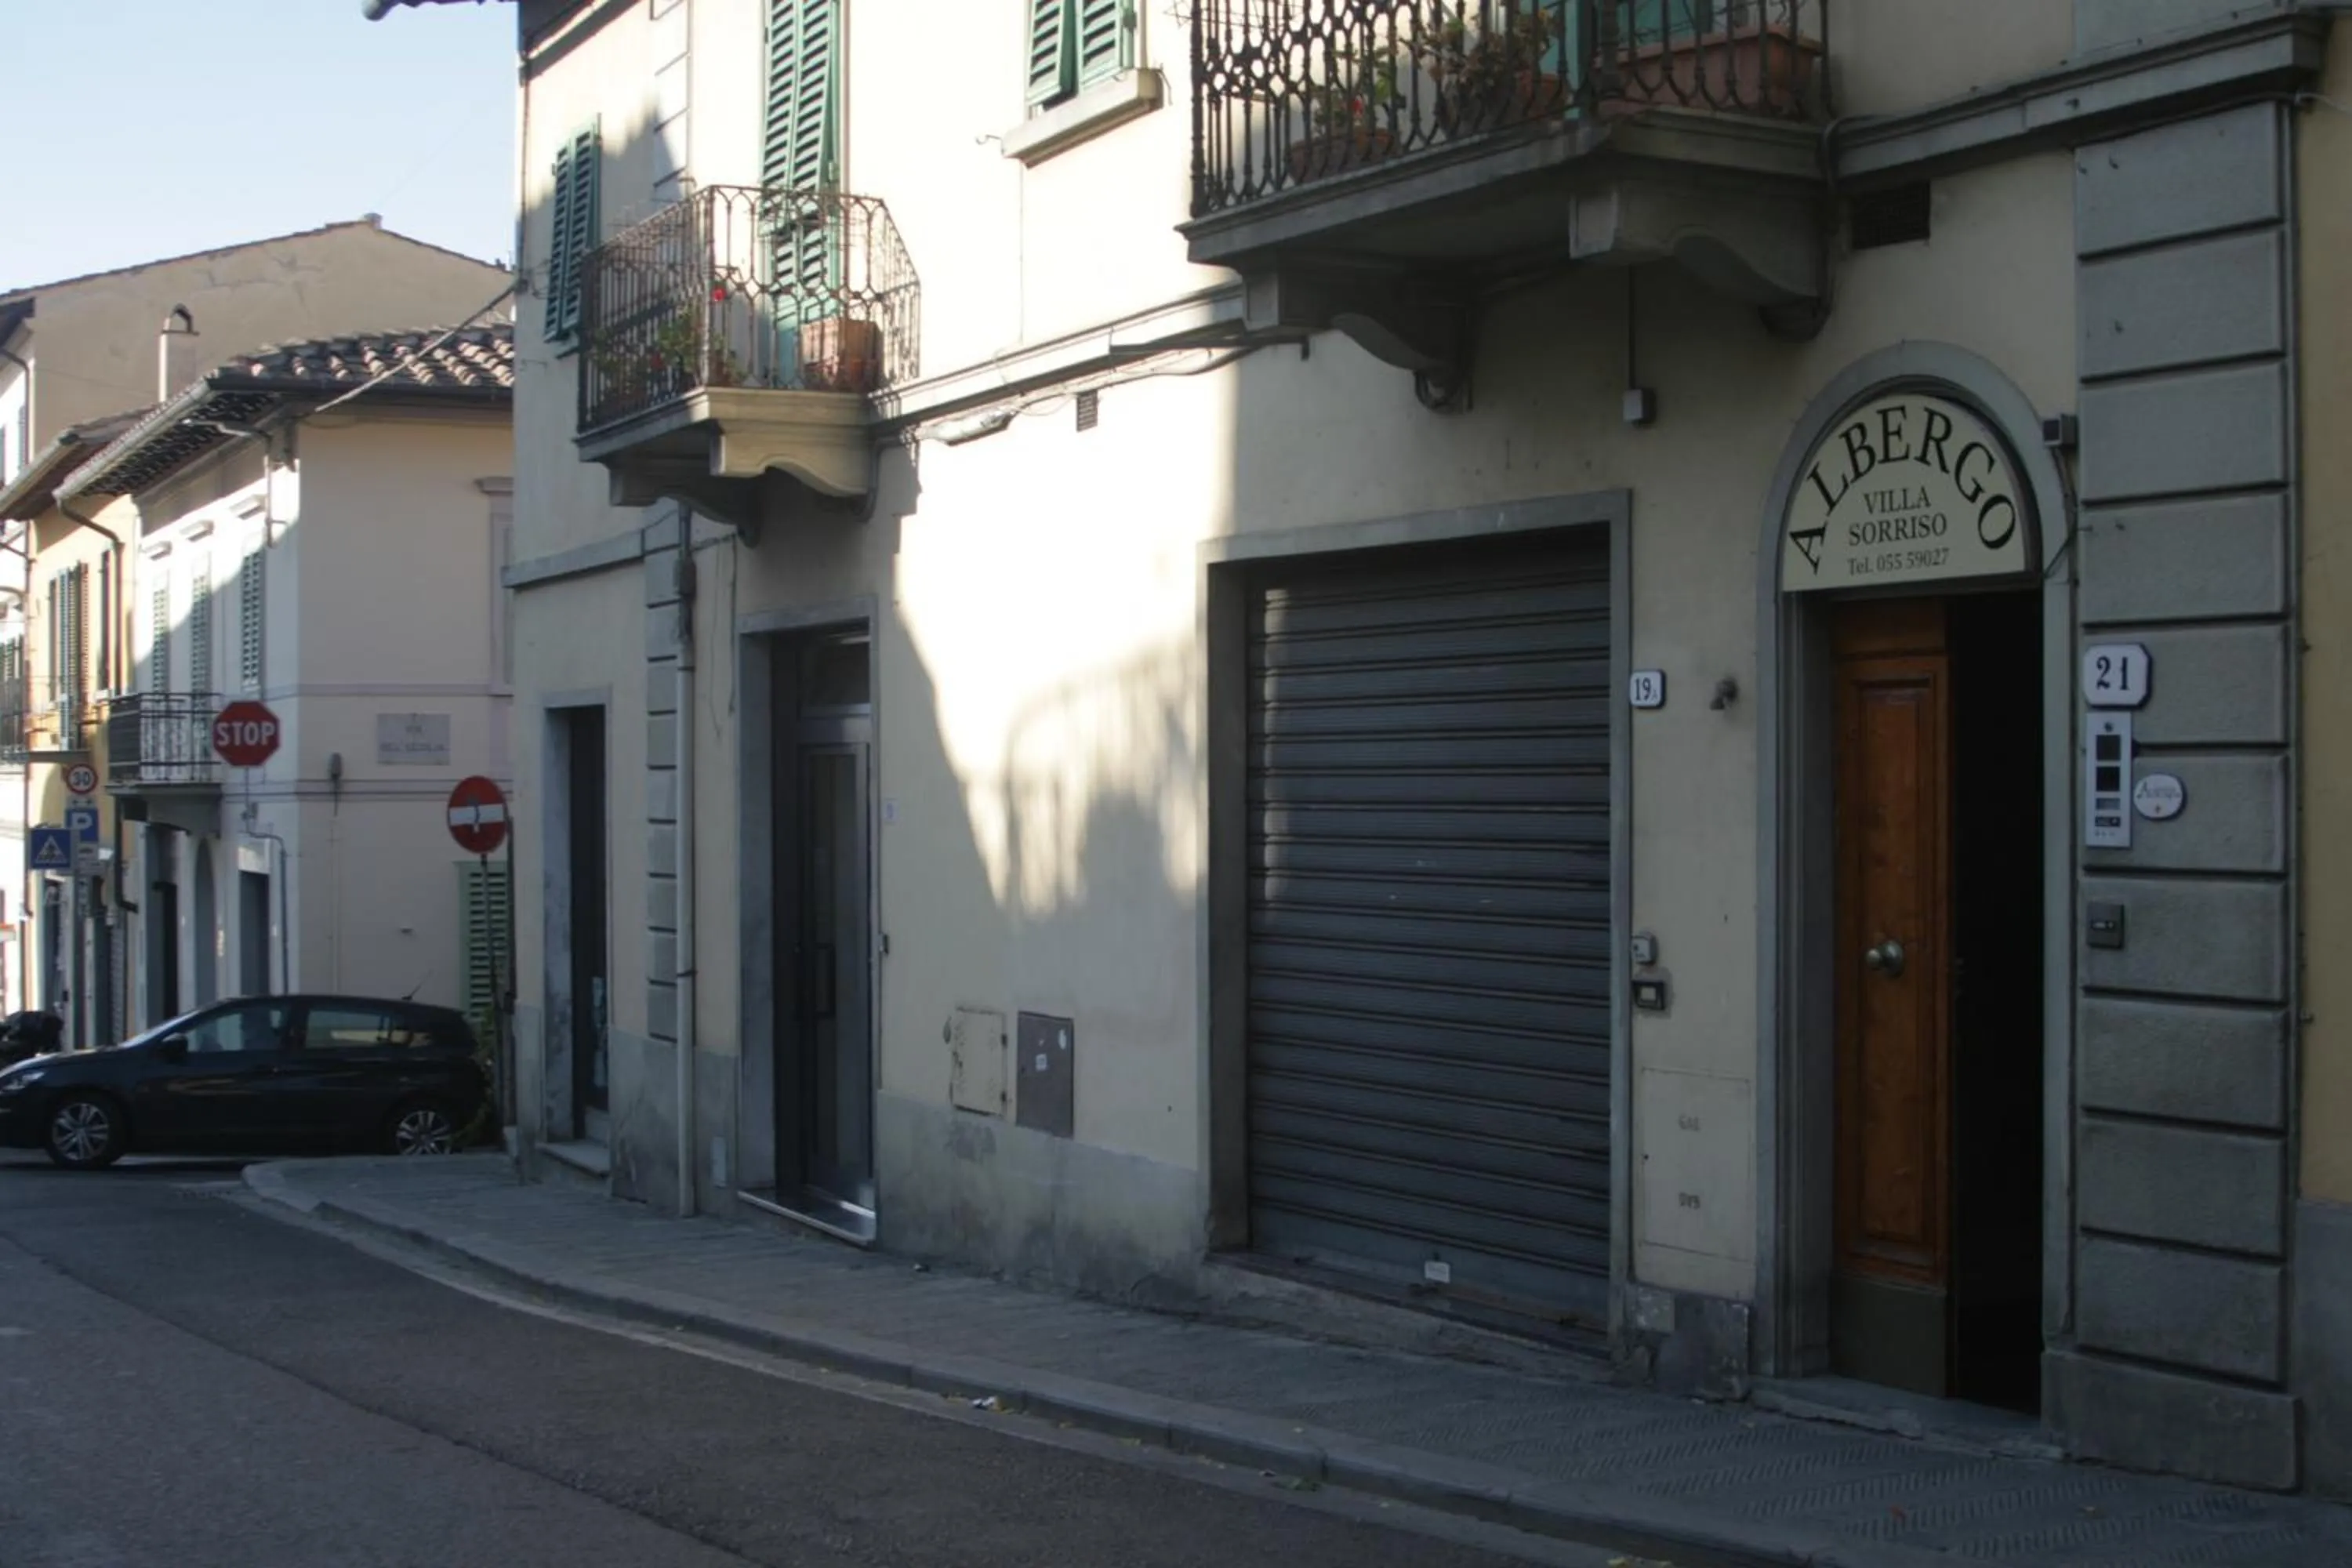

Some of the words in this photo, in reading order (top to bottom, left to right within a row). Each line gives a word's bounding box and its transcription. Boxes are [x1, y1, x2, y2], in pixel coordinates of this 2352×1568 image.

[1789, 405, 2017, 575] ALBERGO
[1864, 485, 1932, 515] VILLA
[1848, 512, 1947, 546] SORRISO
[1847, 557, 1873, 576] Tel.
[1877, 553, 1903, 572] 055
[1907, 547, 1951, 569] 59027
[2096, 656, 2130, 691] 21
[216, 722, 275, 746] STOP
[72, 771, 90, 785] 30
